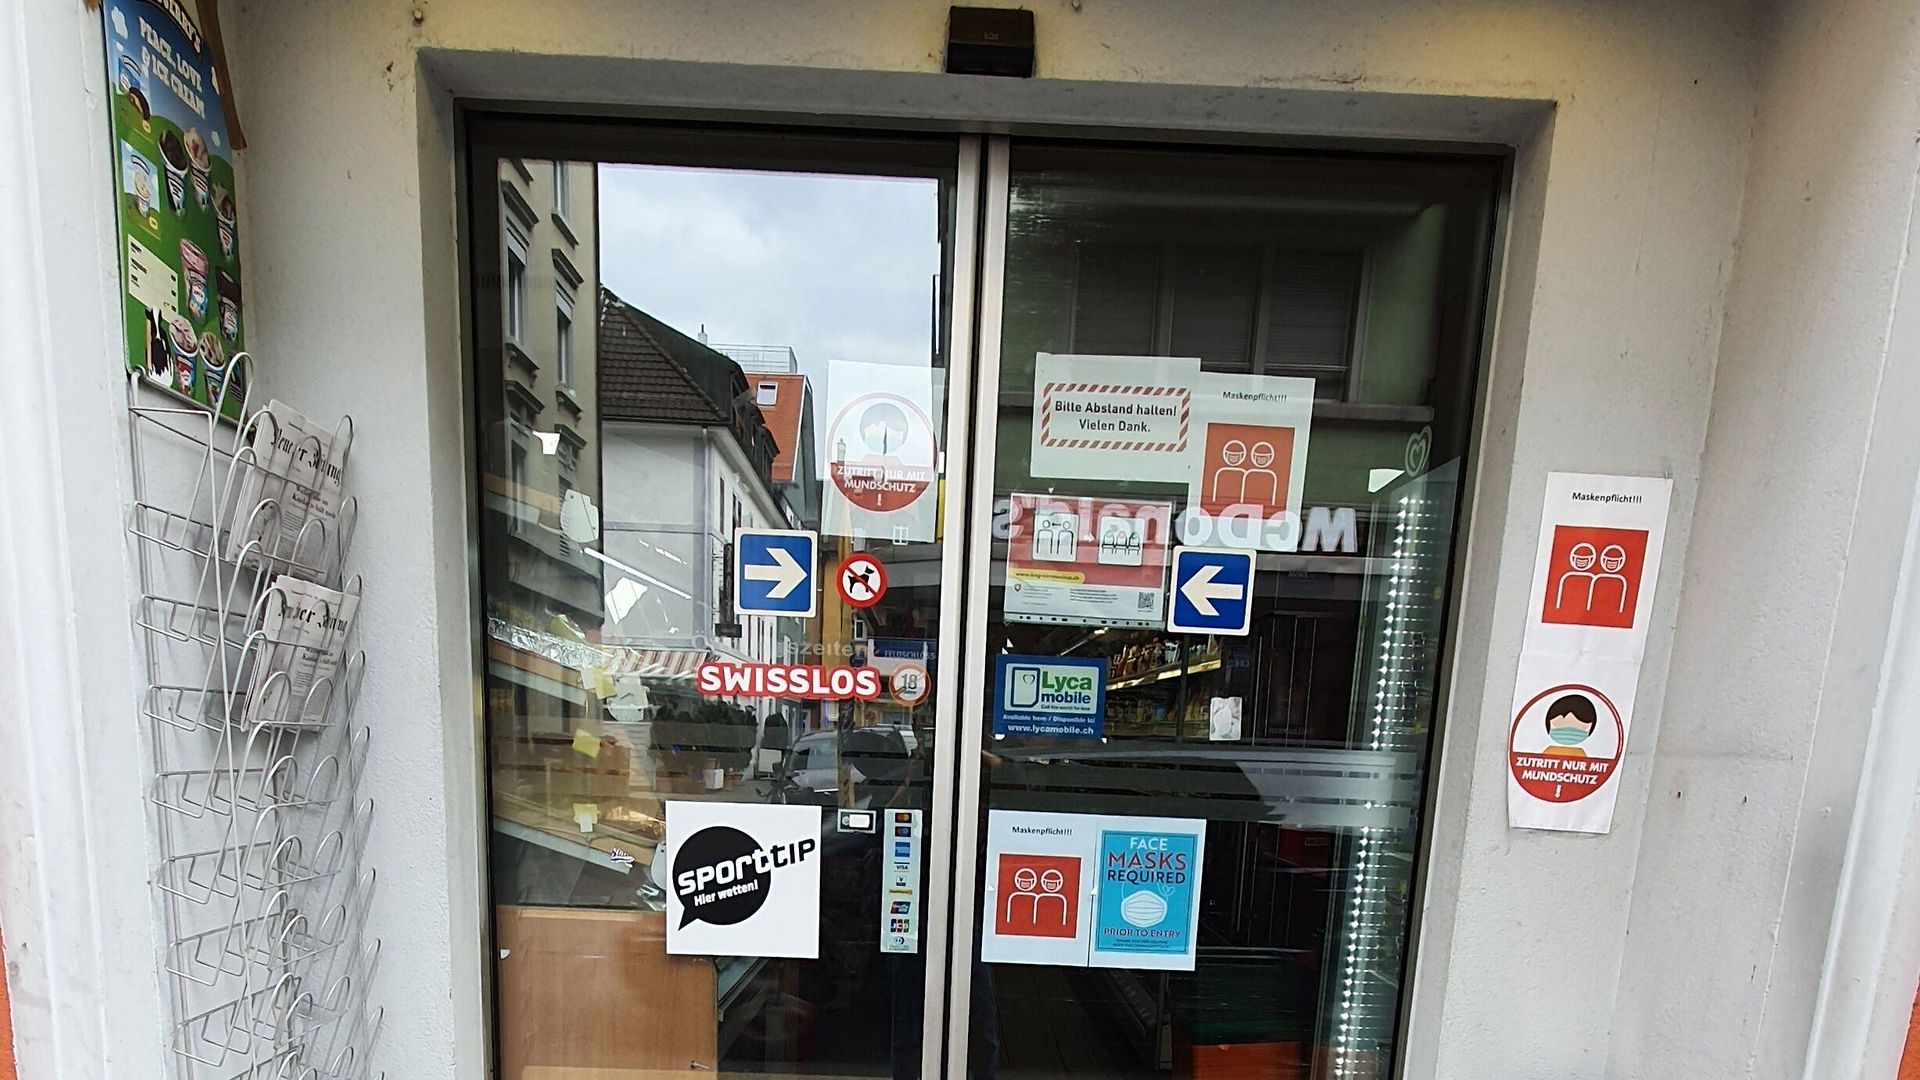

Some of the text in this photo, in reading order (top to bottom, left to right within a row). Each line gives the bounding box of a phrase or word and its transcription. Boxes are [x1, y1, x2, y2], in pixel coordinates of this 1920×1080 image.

[152, 54, 172, 88] ICE
[170, 74, 206, 119] CREAM
[1222, 391, 1287, 402] Maskenpflicht!!!
[1055, 401, 1177, 417] Bitte Abstand halten!
[1079, 419, 1151, 433] Vielen Dank.
[837, 465, 926, 480] ZUTRITT NUR MIT
[844, 478, 917, 492] MUNDSCHUTZ
[1572, 492, 1642, 504] Maskenpflicht!!!
[700, 665, 877, 697] SWISSLOS
[902, 674, 918, 690] 18
[1041, 671, 1093, 693] Lyca
[1041, 691, 1091, 704] mobile
[1007, 723, 1094, 735] www.lycamobile.ch
[1516, 756, 1609, 774] ZUTRITT NUR MIT
[1521, 769, 1598, 786] MUNDSCHUTZ
[1555, 784, 1562, 798] !
[1012, 826, 1073, 837] Maskenpflicht!!!
[1129, 837, 1168, 851] FACE
[1107, 851, 1187, 870] MASKS
[1107, 869, 1186, 885] REQUIRED
[694, 879, 758, 907] Hier wetten!
[1104, 927, 1181, 939] PRIOR TO ENTRY
